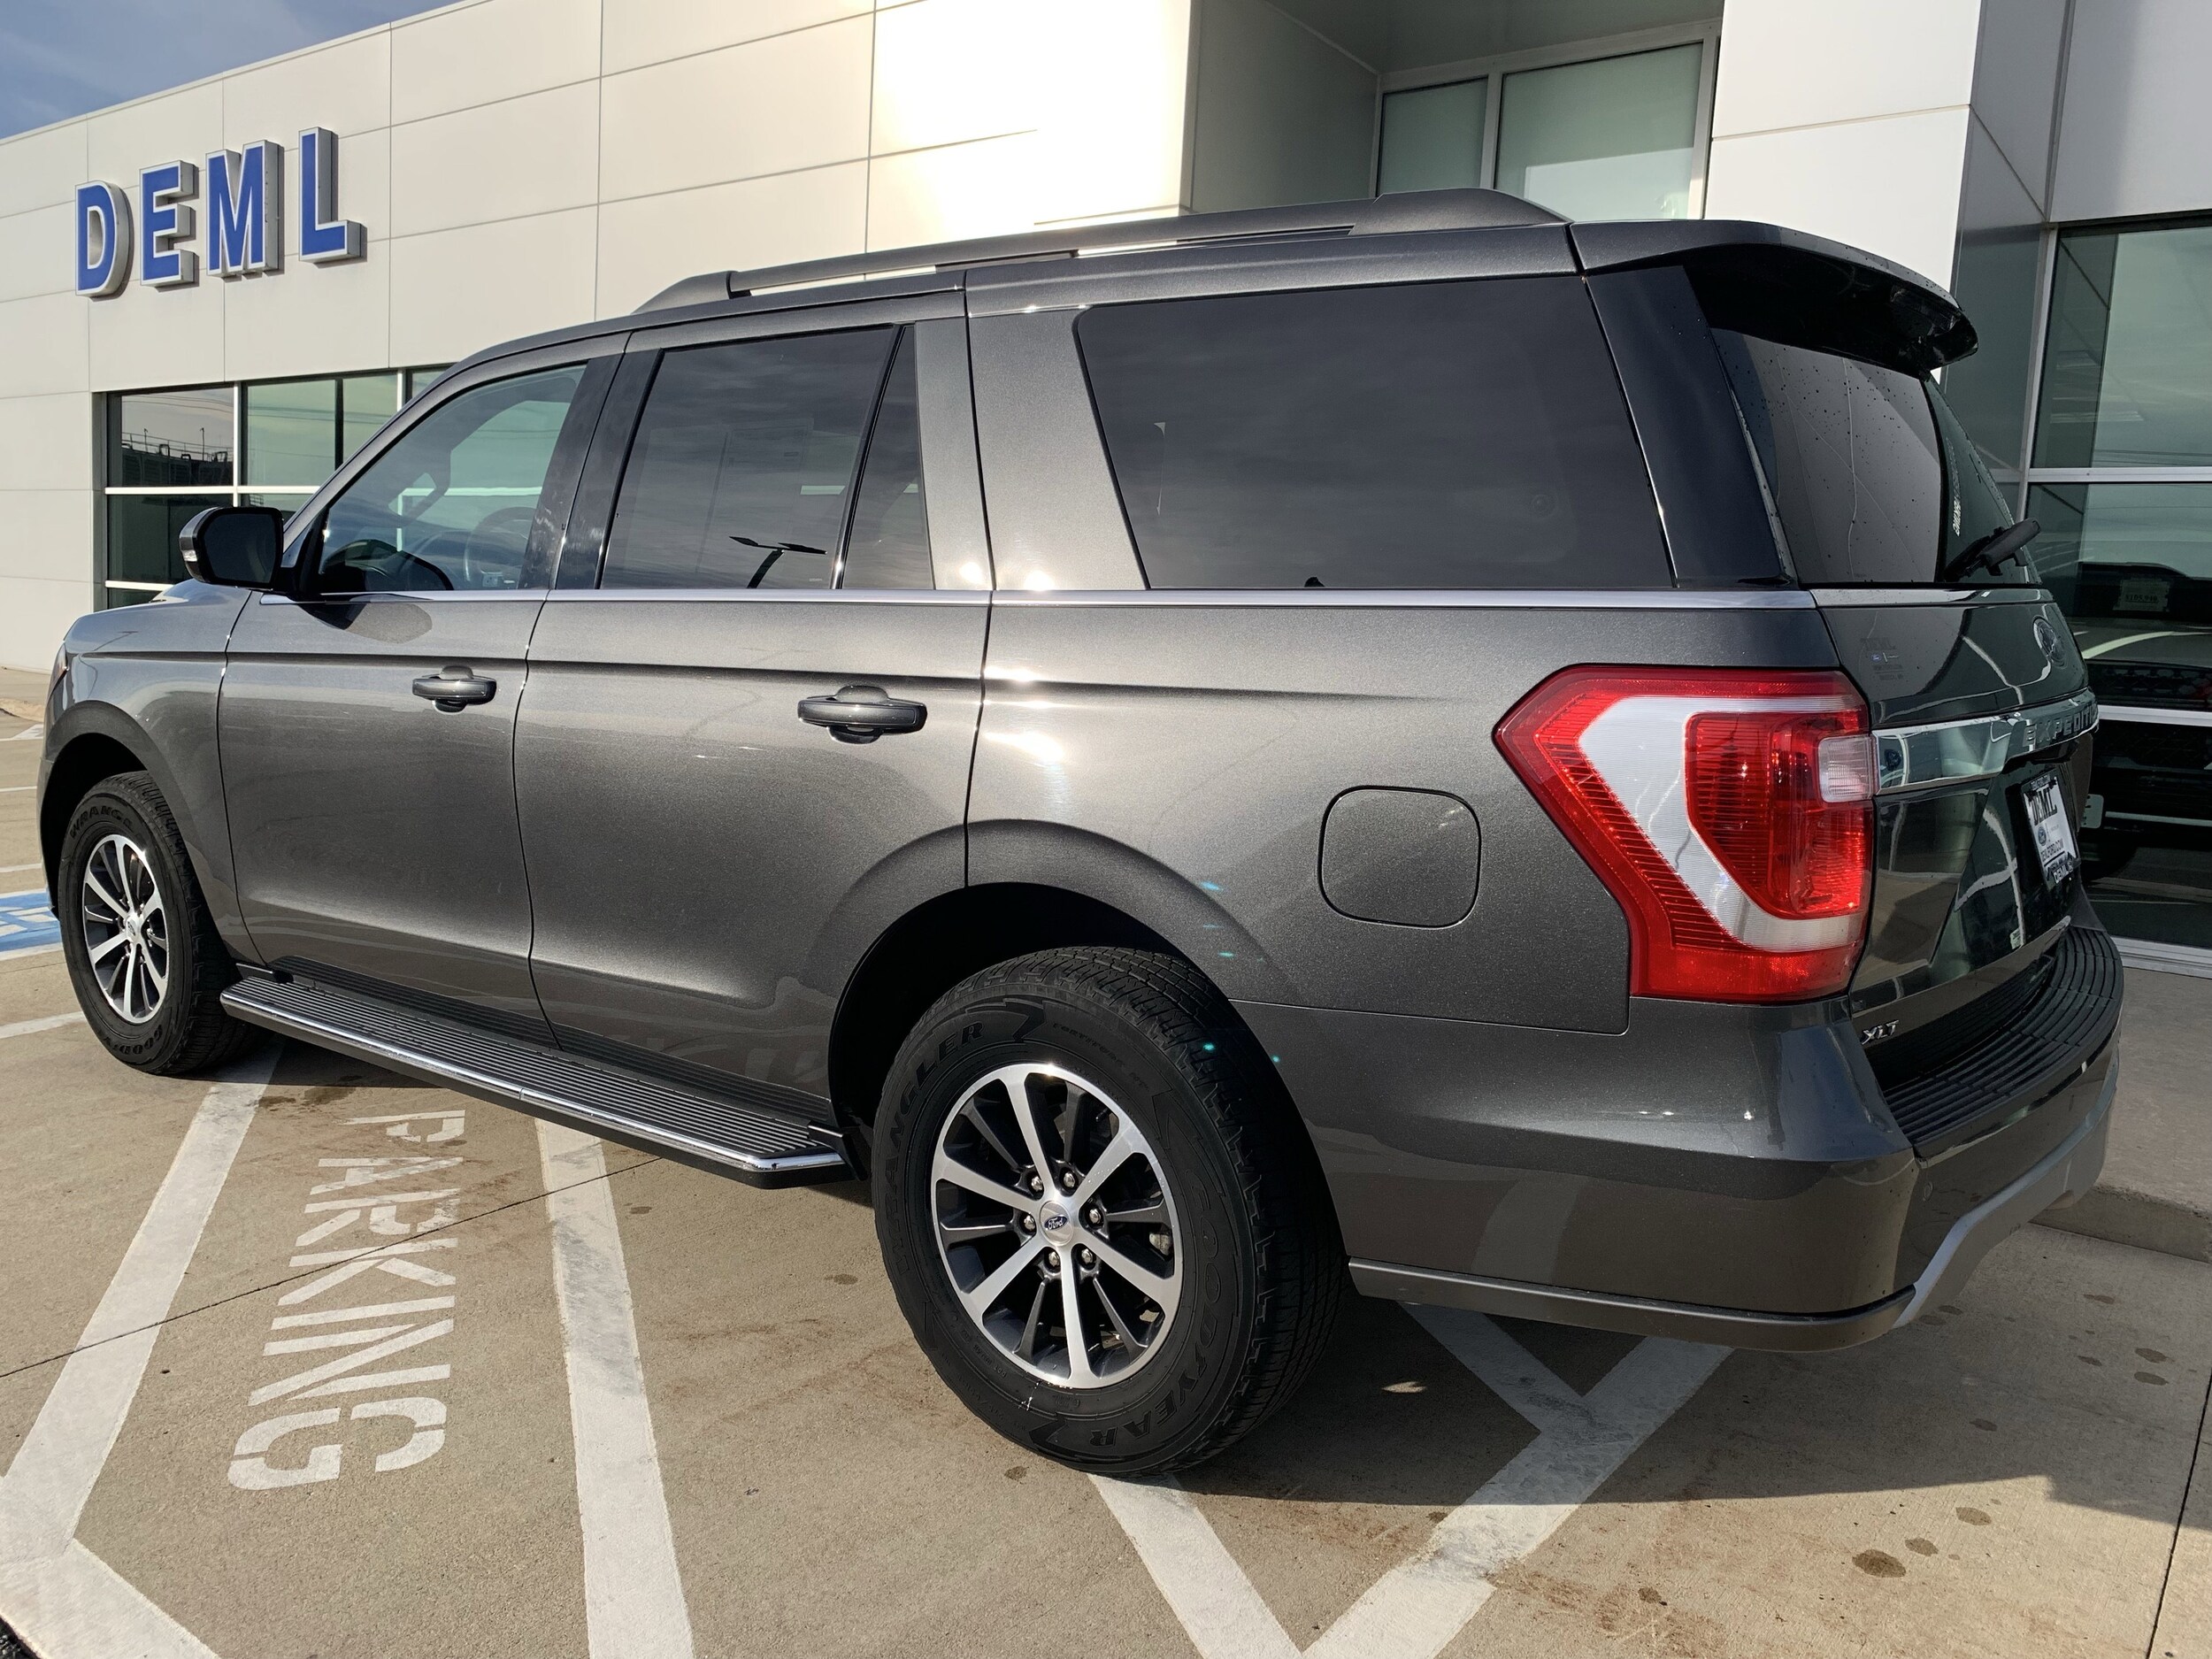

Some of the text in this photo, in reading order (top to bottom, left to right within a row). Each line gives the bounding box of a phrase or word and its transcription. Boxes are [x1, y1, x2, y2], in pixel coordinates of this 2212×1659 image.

[74, 127, 364, 298] DEML
[1861, 1019, 1900, 1045] XLT
[884, 1020, 983, 1276] WRANGLER
[1047, 1217, 1065, 1230] Ford
[227, 1110, 466, 1491] PARKING
[1090, 1168, 1222, 1448] GOODYEAR
